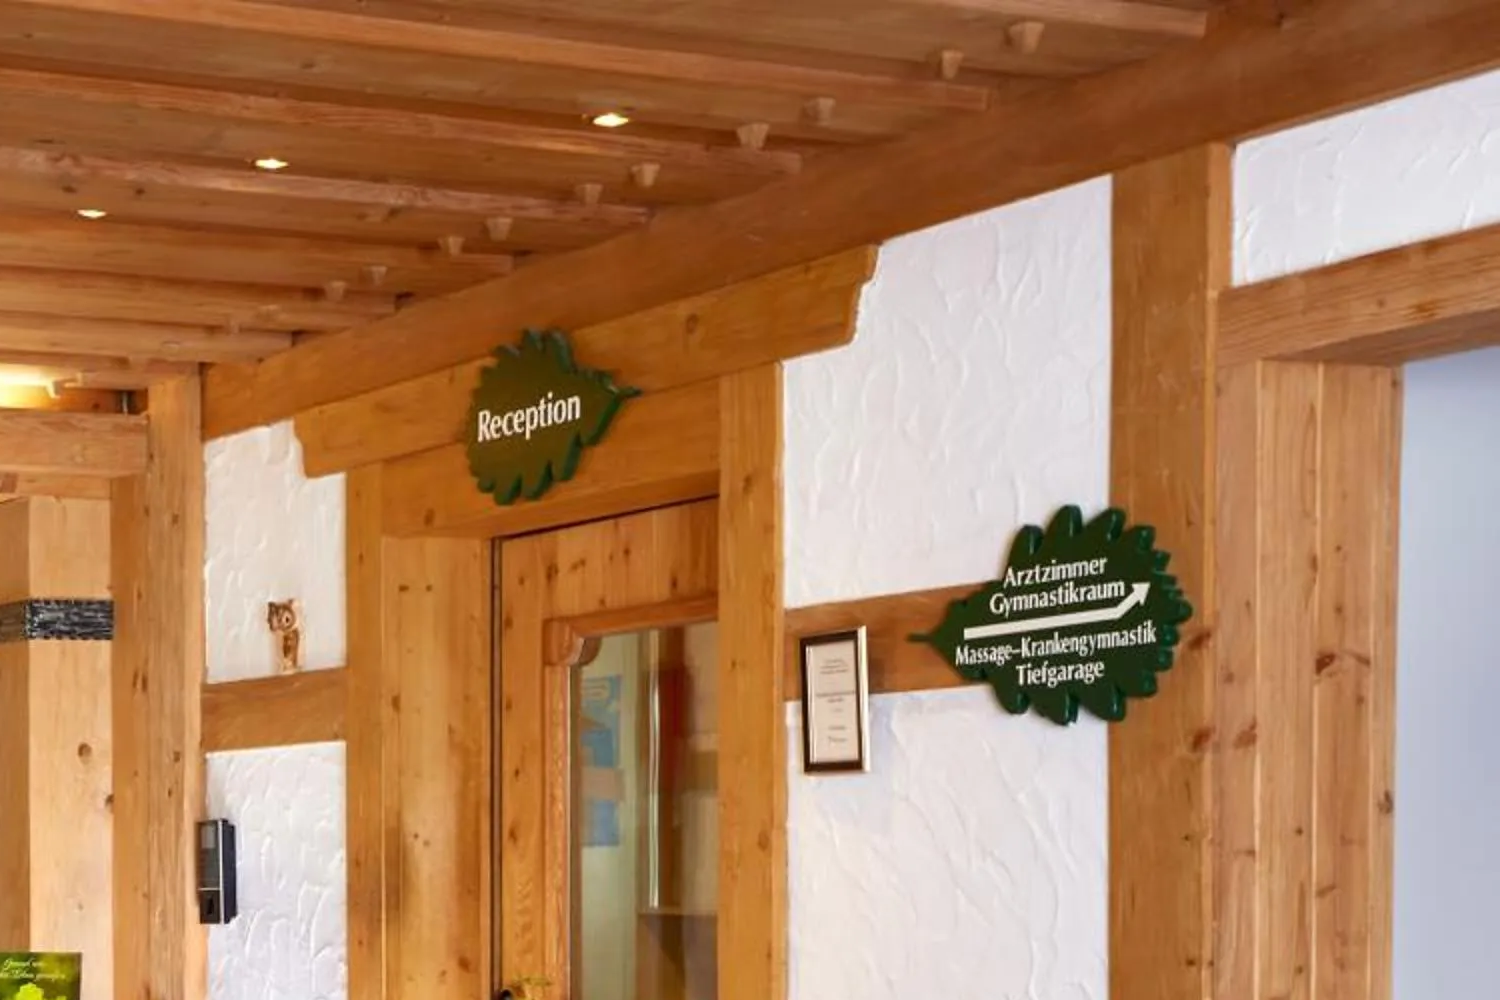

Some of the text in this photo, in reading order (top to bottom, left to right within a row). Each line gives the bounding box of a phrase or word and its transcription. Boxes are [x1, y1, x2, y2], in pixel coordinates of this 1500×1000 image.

[477, 391, 581, 442] Reception
[1003, 557, 1108, 588] Arztzimmer
[989, 580, 1125, 618] Gymnastikraum
[1015, 660, 1105, 688] Tiefgarage
